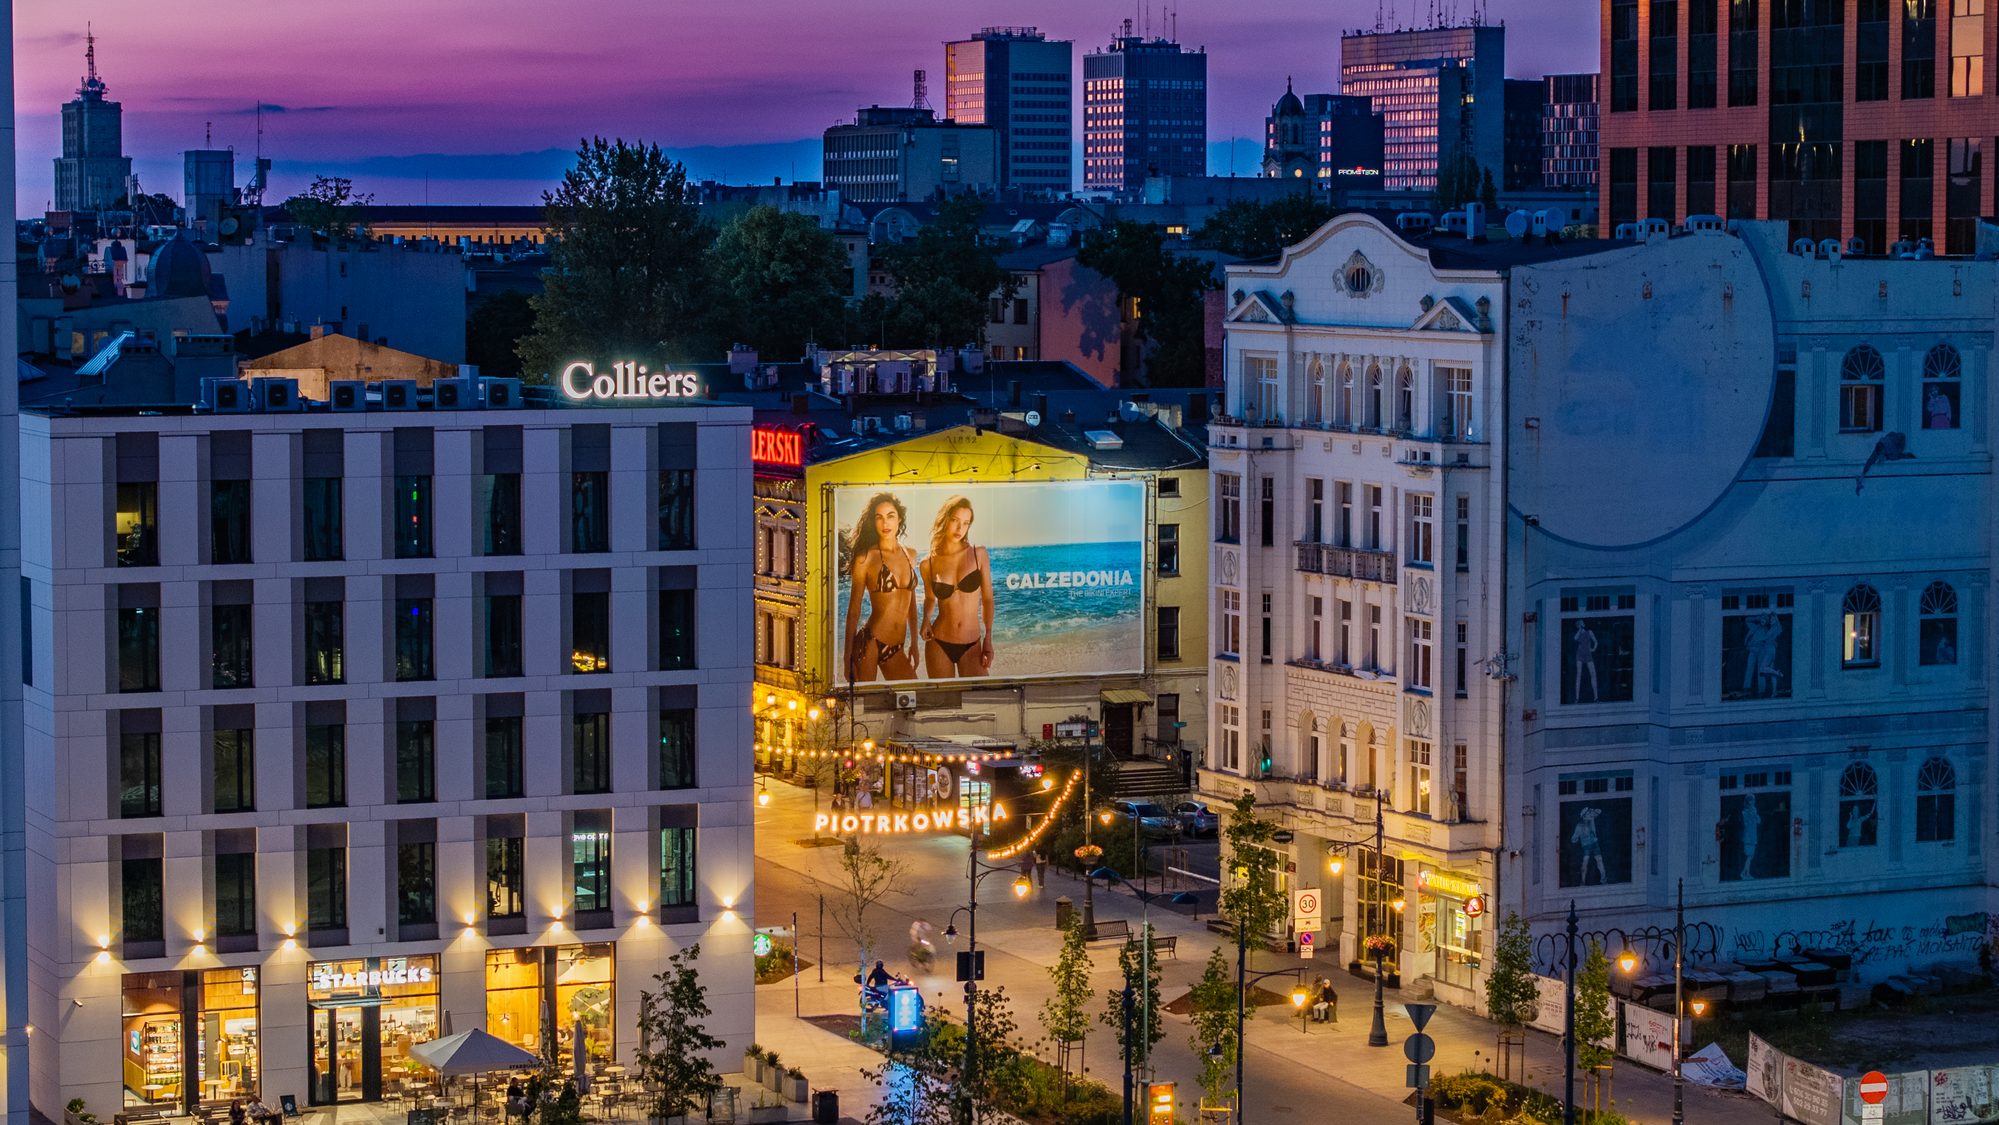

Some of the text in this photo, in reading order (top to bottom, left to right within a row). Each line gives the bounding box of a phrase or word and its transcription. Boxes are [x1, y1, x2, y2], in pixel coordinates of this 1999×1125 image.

[562, 361, 697, 398] Colliers
[752, 430, 800, 465] LERSKI
[1006, 570, 1133, 590] CALZEDONIA
[815, 803, 1008, 833] PIOTRKOWSKA
[1302, 900, 1314, 909] 30
[319, 966, 432, 988] STARBUCKS
